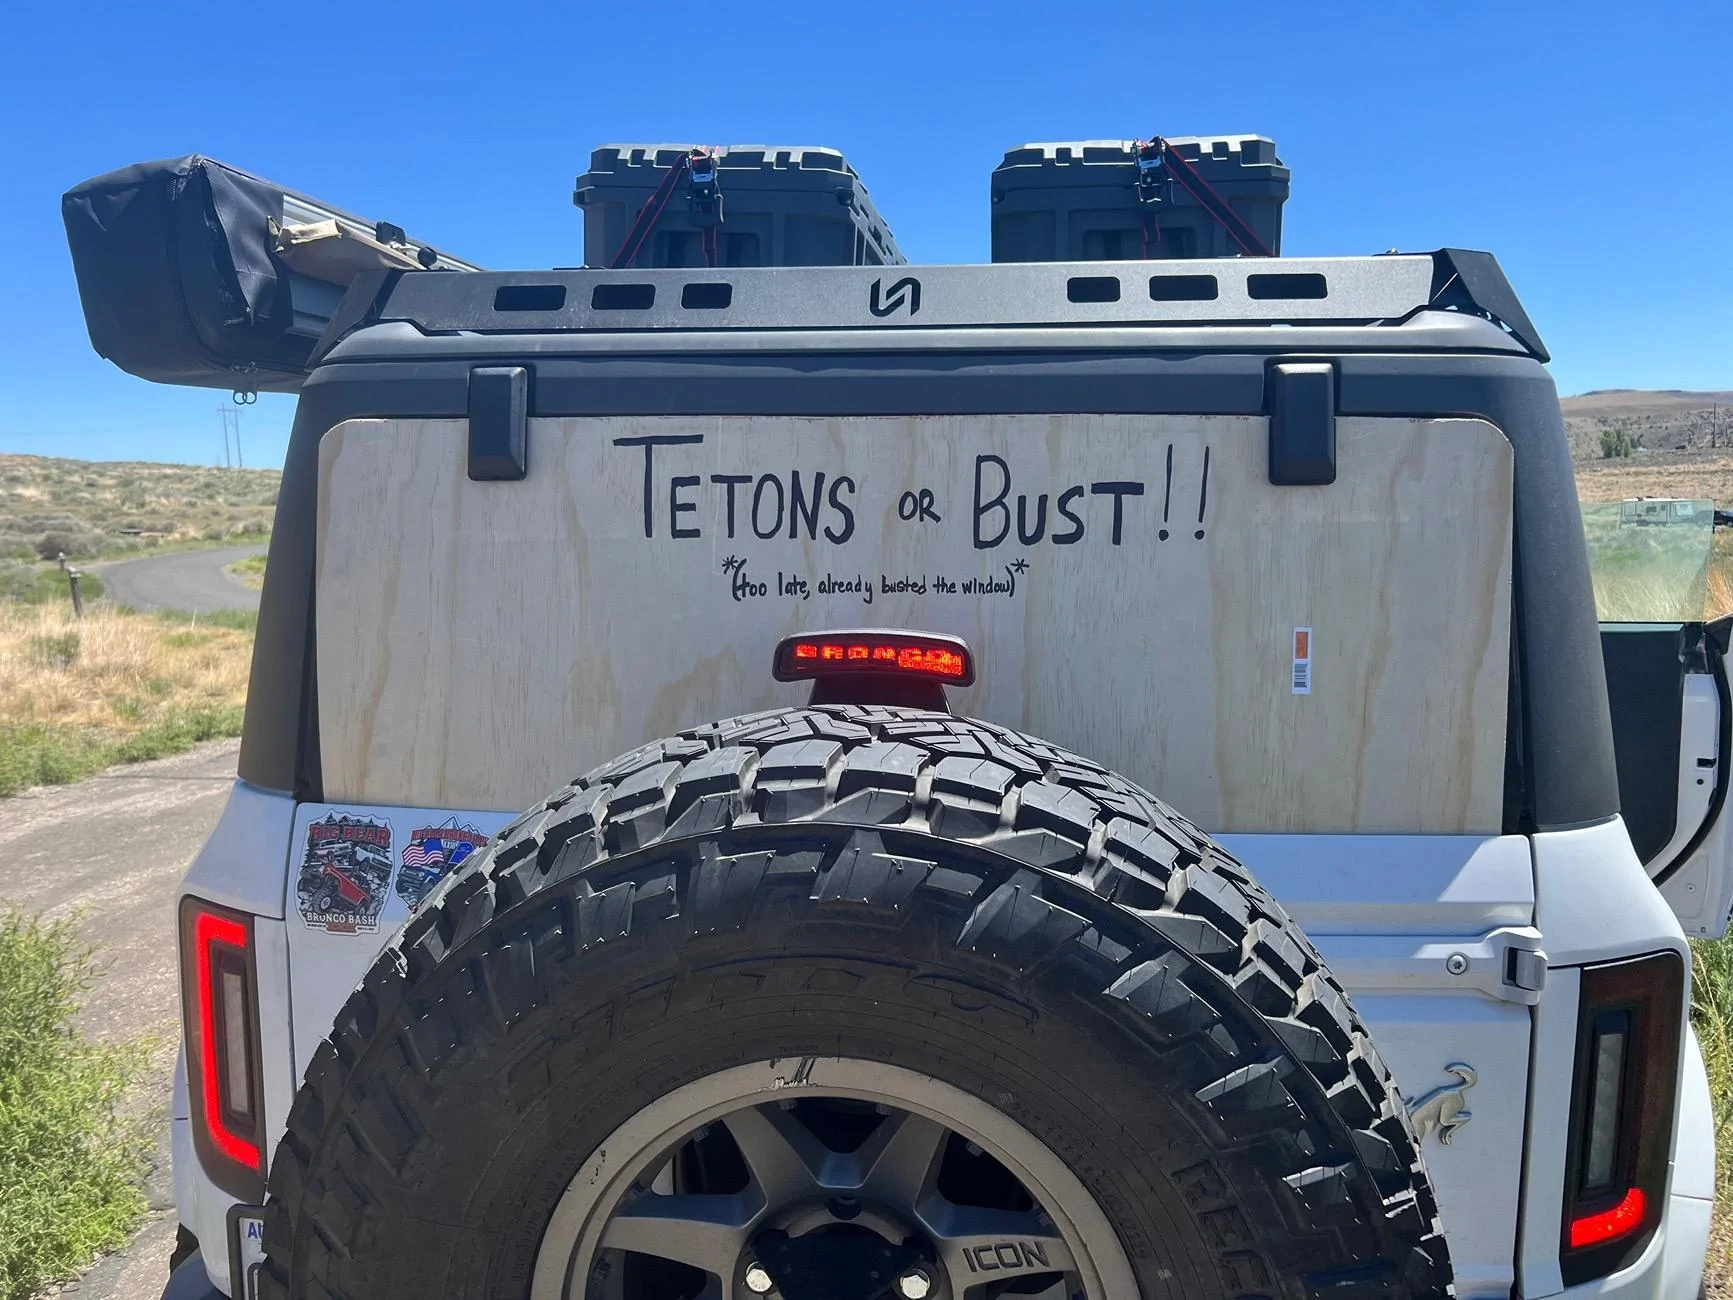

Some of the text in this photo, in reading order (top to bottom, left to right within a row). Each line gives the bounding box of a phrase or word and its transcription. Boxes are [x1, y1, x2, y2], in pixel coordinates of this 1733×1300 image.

[613, 434, 855, 545] TETONS
[898, 490, 941, 523] OR
[778, 571, 810, 600] late,
[818, 573, 873, 604] already
[881, 574, 927, 595] busted
[933, 575, 957, 594] the
[306, 912, 375, 926] BRONCO BASH
[962, 1240, 1050, 1273] ICON
